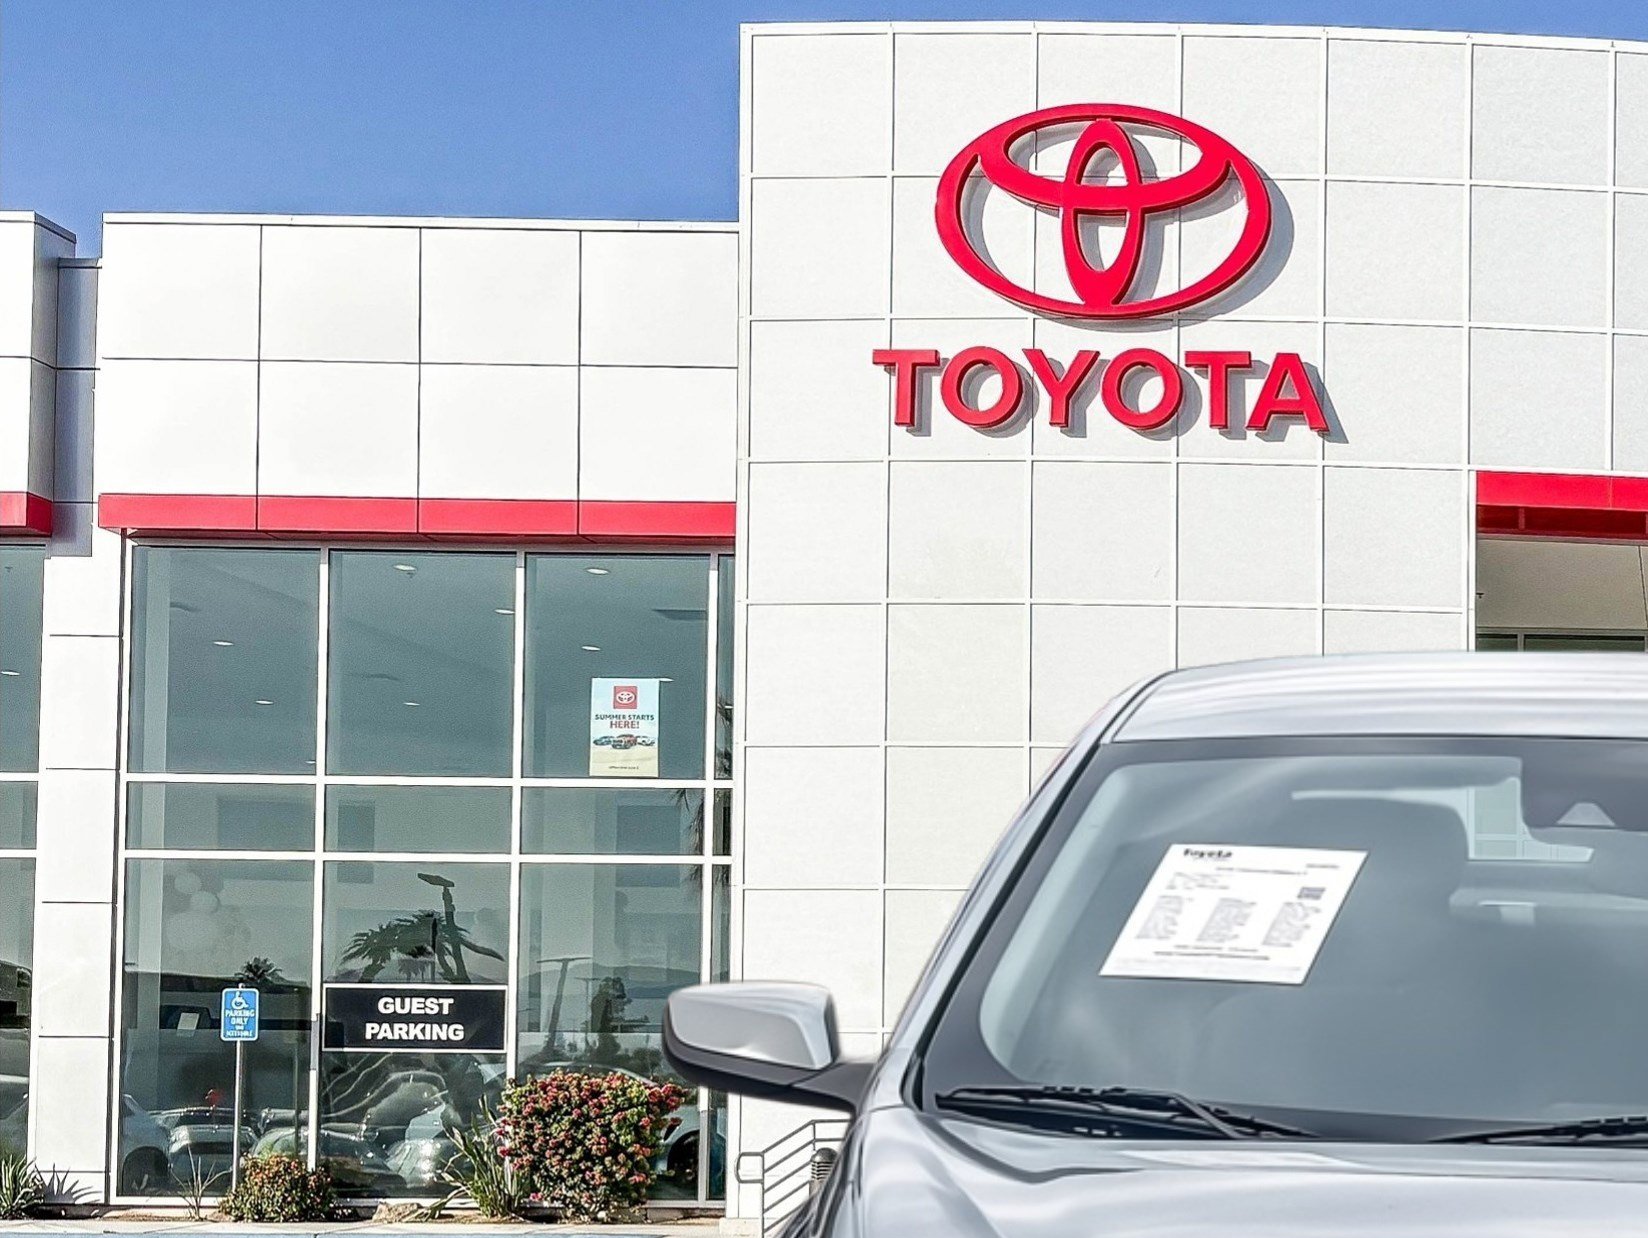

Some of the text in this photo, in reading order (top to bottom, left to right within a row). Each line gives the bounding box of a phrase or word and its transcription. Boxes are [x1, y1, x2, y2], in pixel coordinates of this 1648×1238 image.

[872, 346, 1329, 432] TOYOTA
[609, 721, 640, 729] HERE!
[377, 997, 454, 1015] GUEST
[365, 1023, 465, 1041] PARKING
